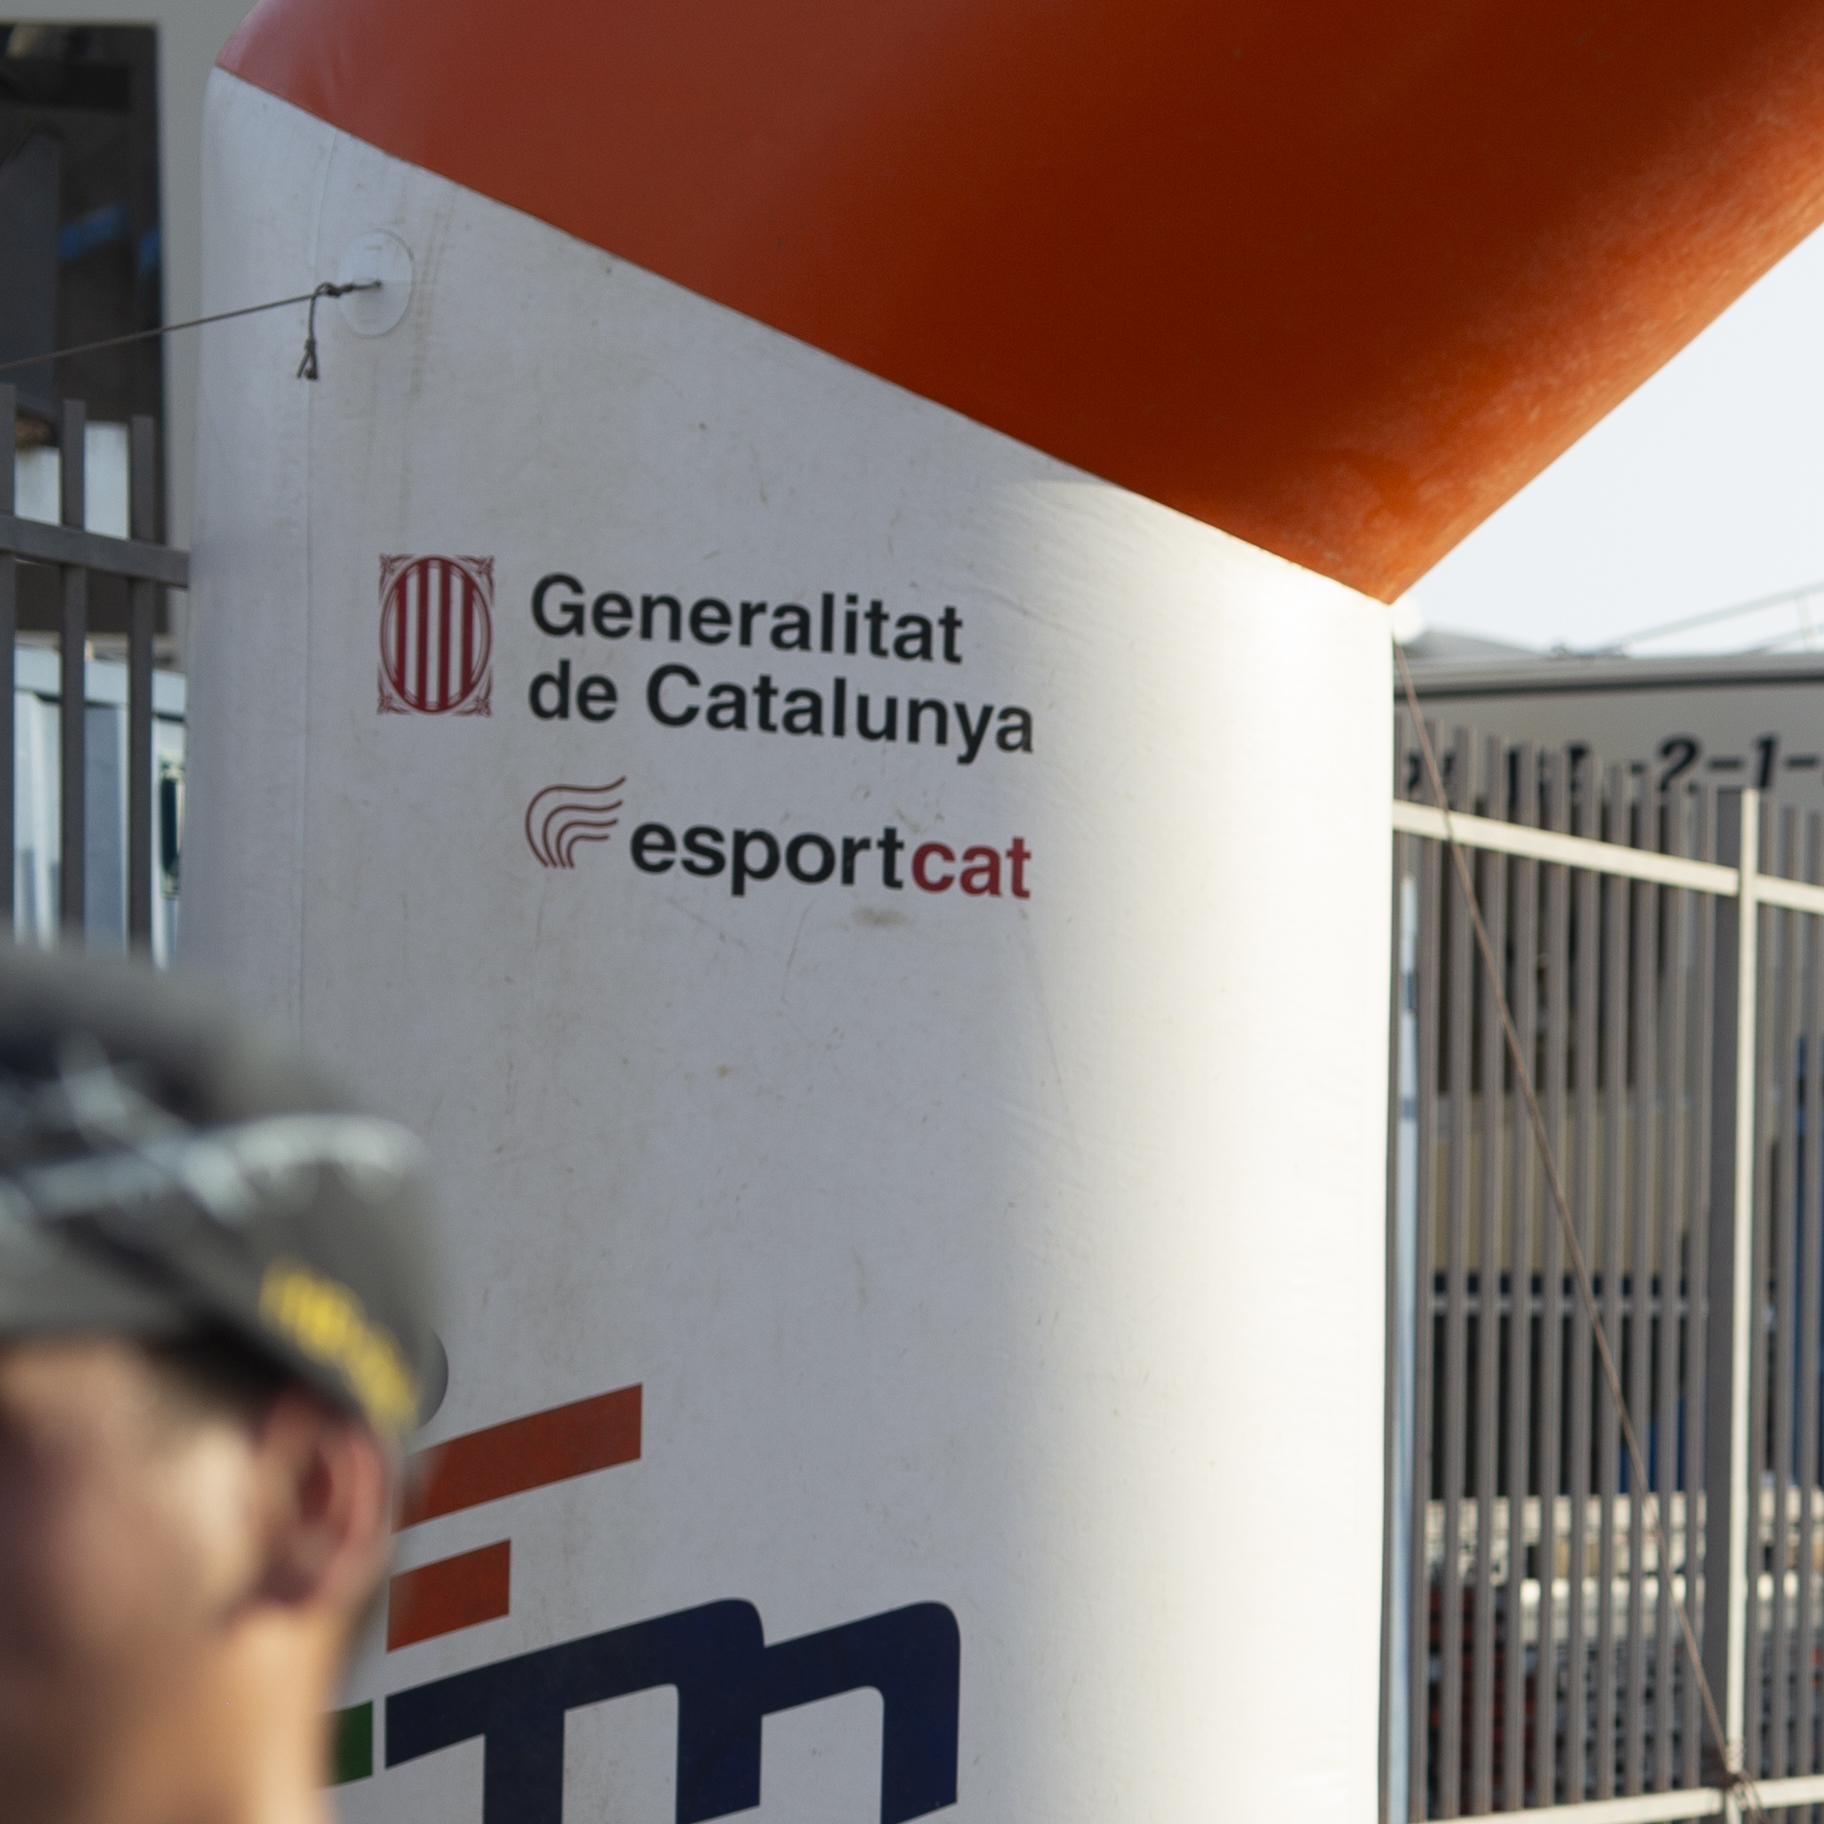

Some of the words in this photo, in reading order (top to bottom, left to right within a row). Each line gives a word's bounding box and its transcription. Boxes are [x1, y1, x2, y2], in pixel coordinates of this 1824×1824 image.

[530, 572, 963, 664] Generalitat
[528, 659, 619, 722] de
[645, 662, 1035, 765] Catalunya
[630, 820, 1031, 899] esportcat
